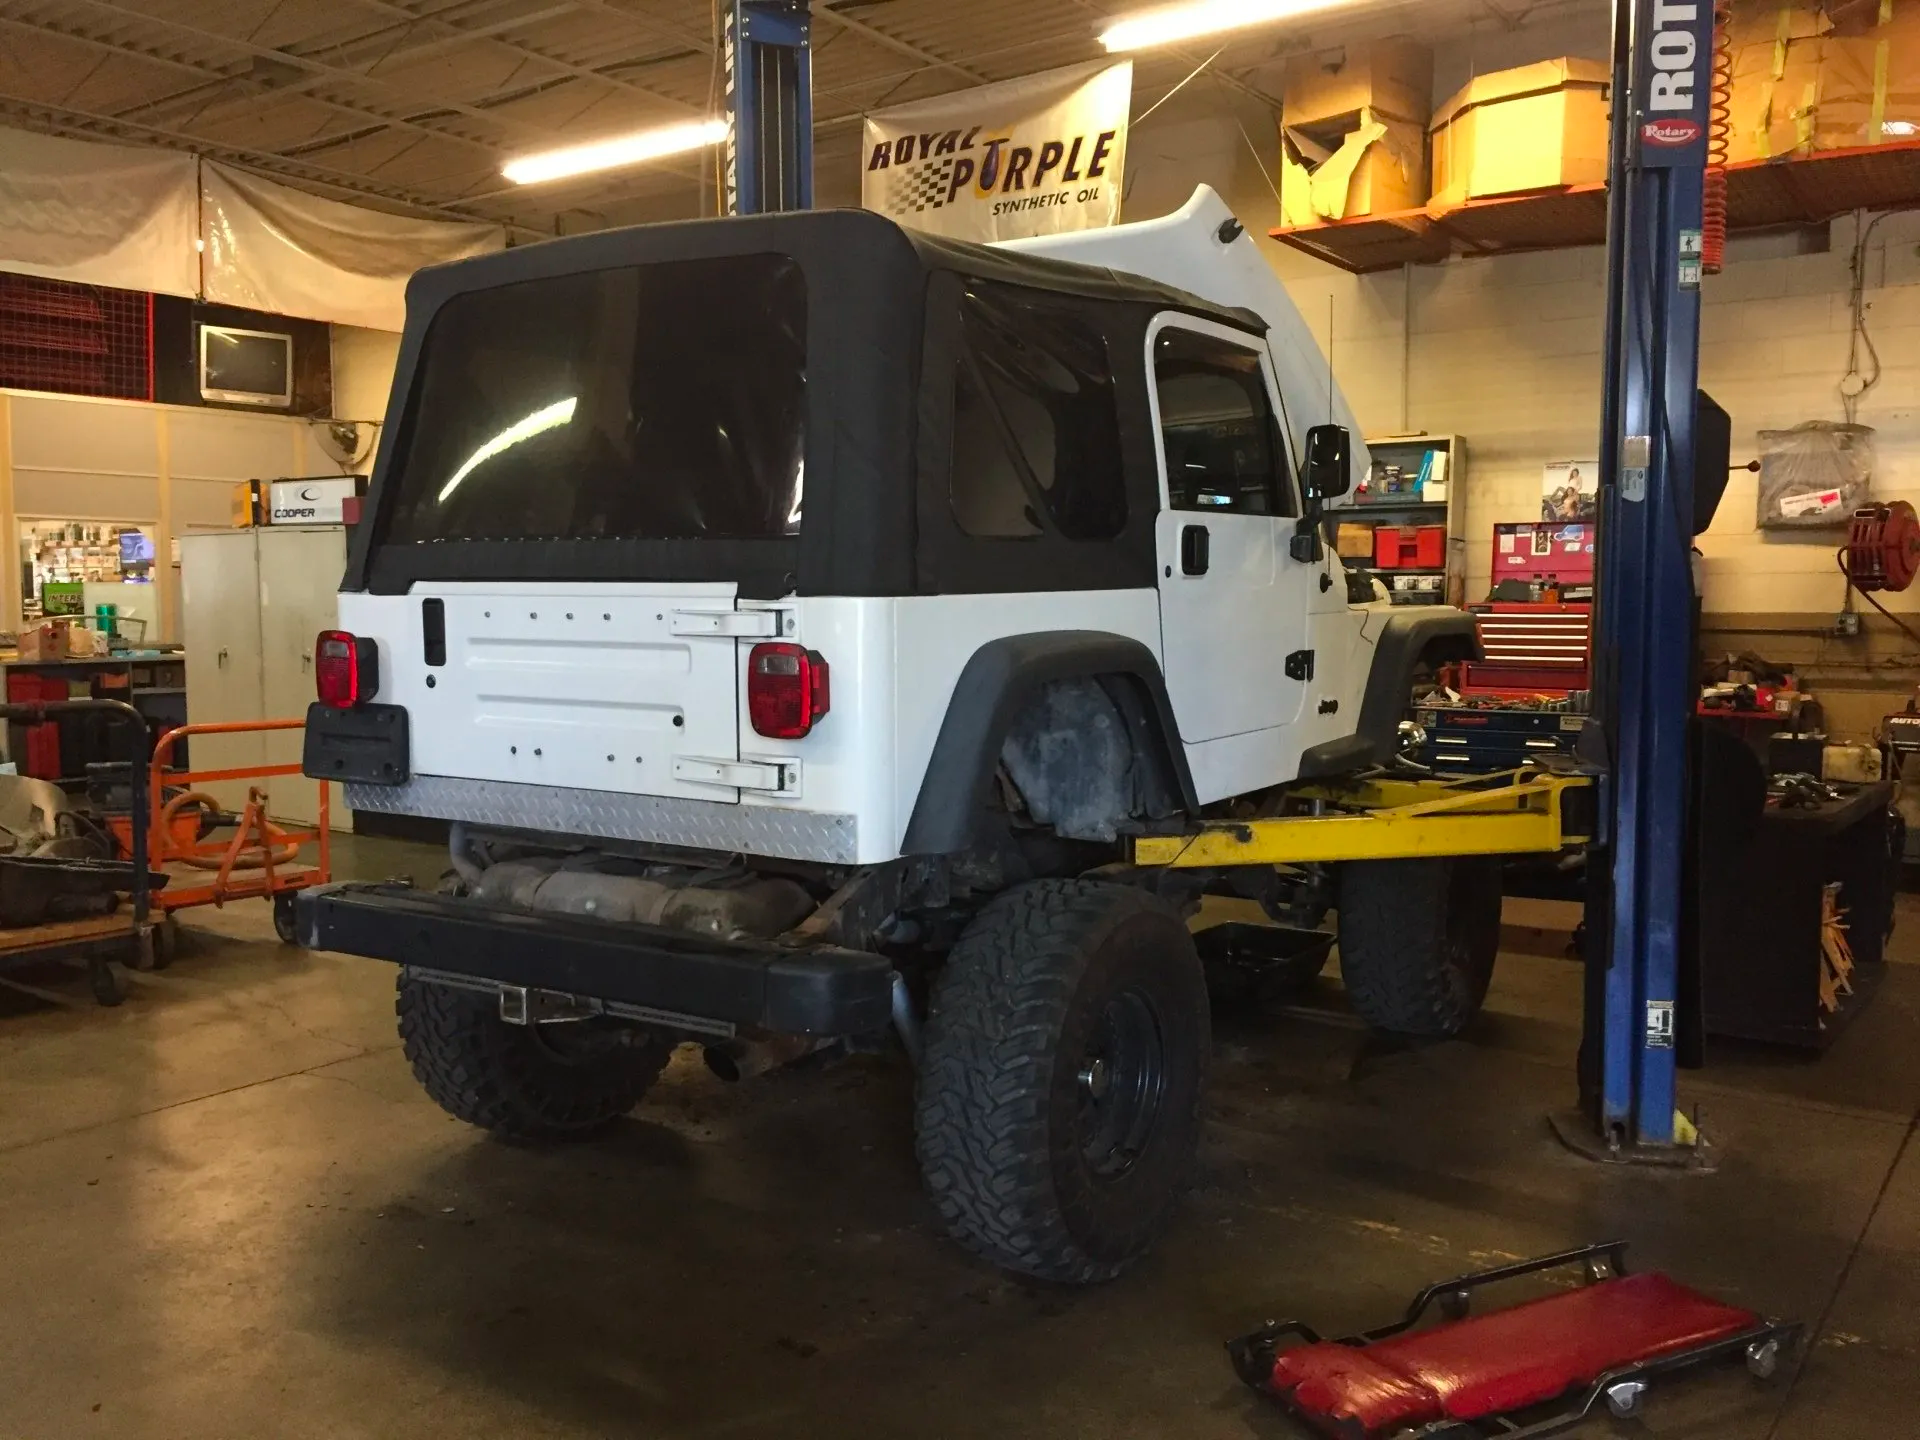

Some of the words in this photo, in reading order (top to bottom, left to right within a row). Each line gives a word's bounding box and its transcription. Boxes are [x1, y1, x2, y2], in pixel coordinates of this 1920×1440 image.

[1650, 0, 1697, 111] ROT
[868, 126, 983, 171] ROYAL
[1644, 125, 1697, 140] Rotary
[947, 131, 1116, 203] PURPLE
[992, 190, 1068, 216] SYNTHETIC
[1076, 187, 1099, 203] OIL
[274, 508, 315, 518] COOPER
